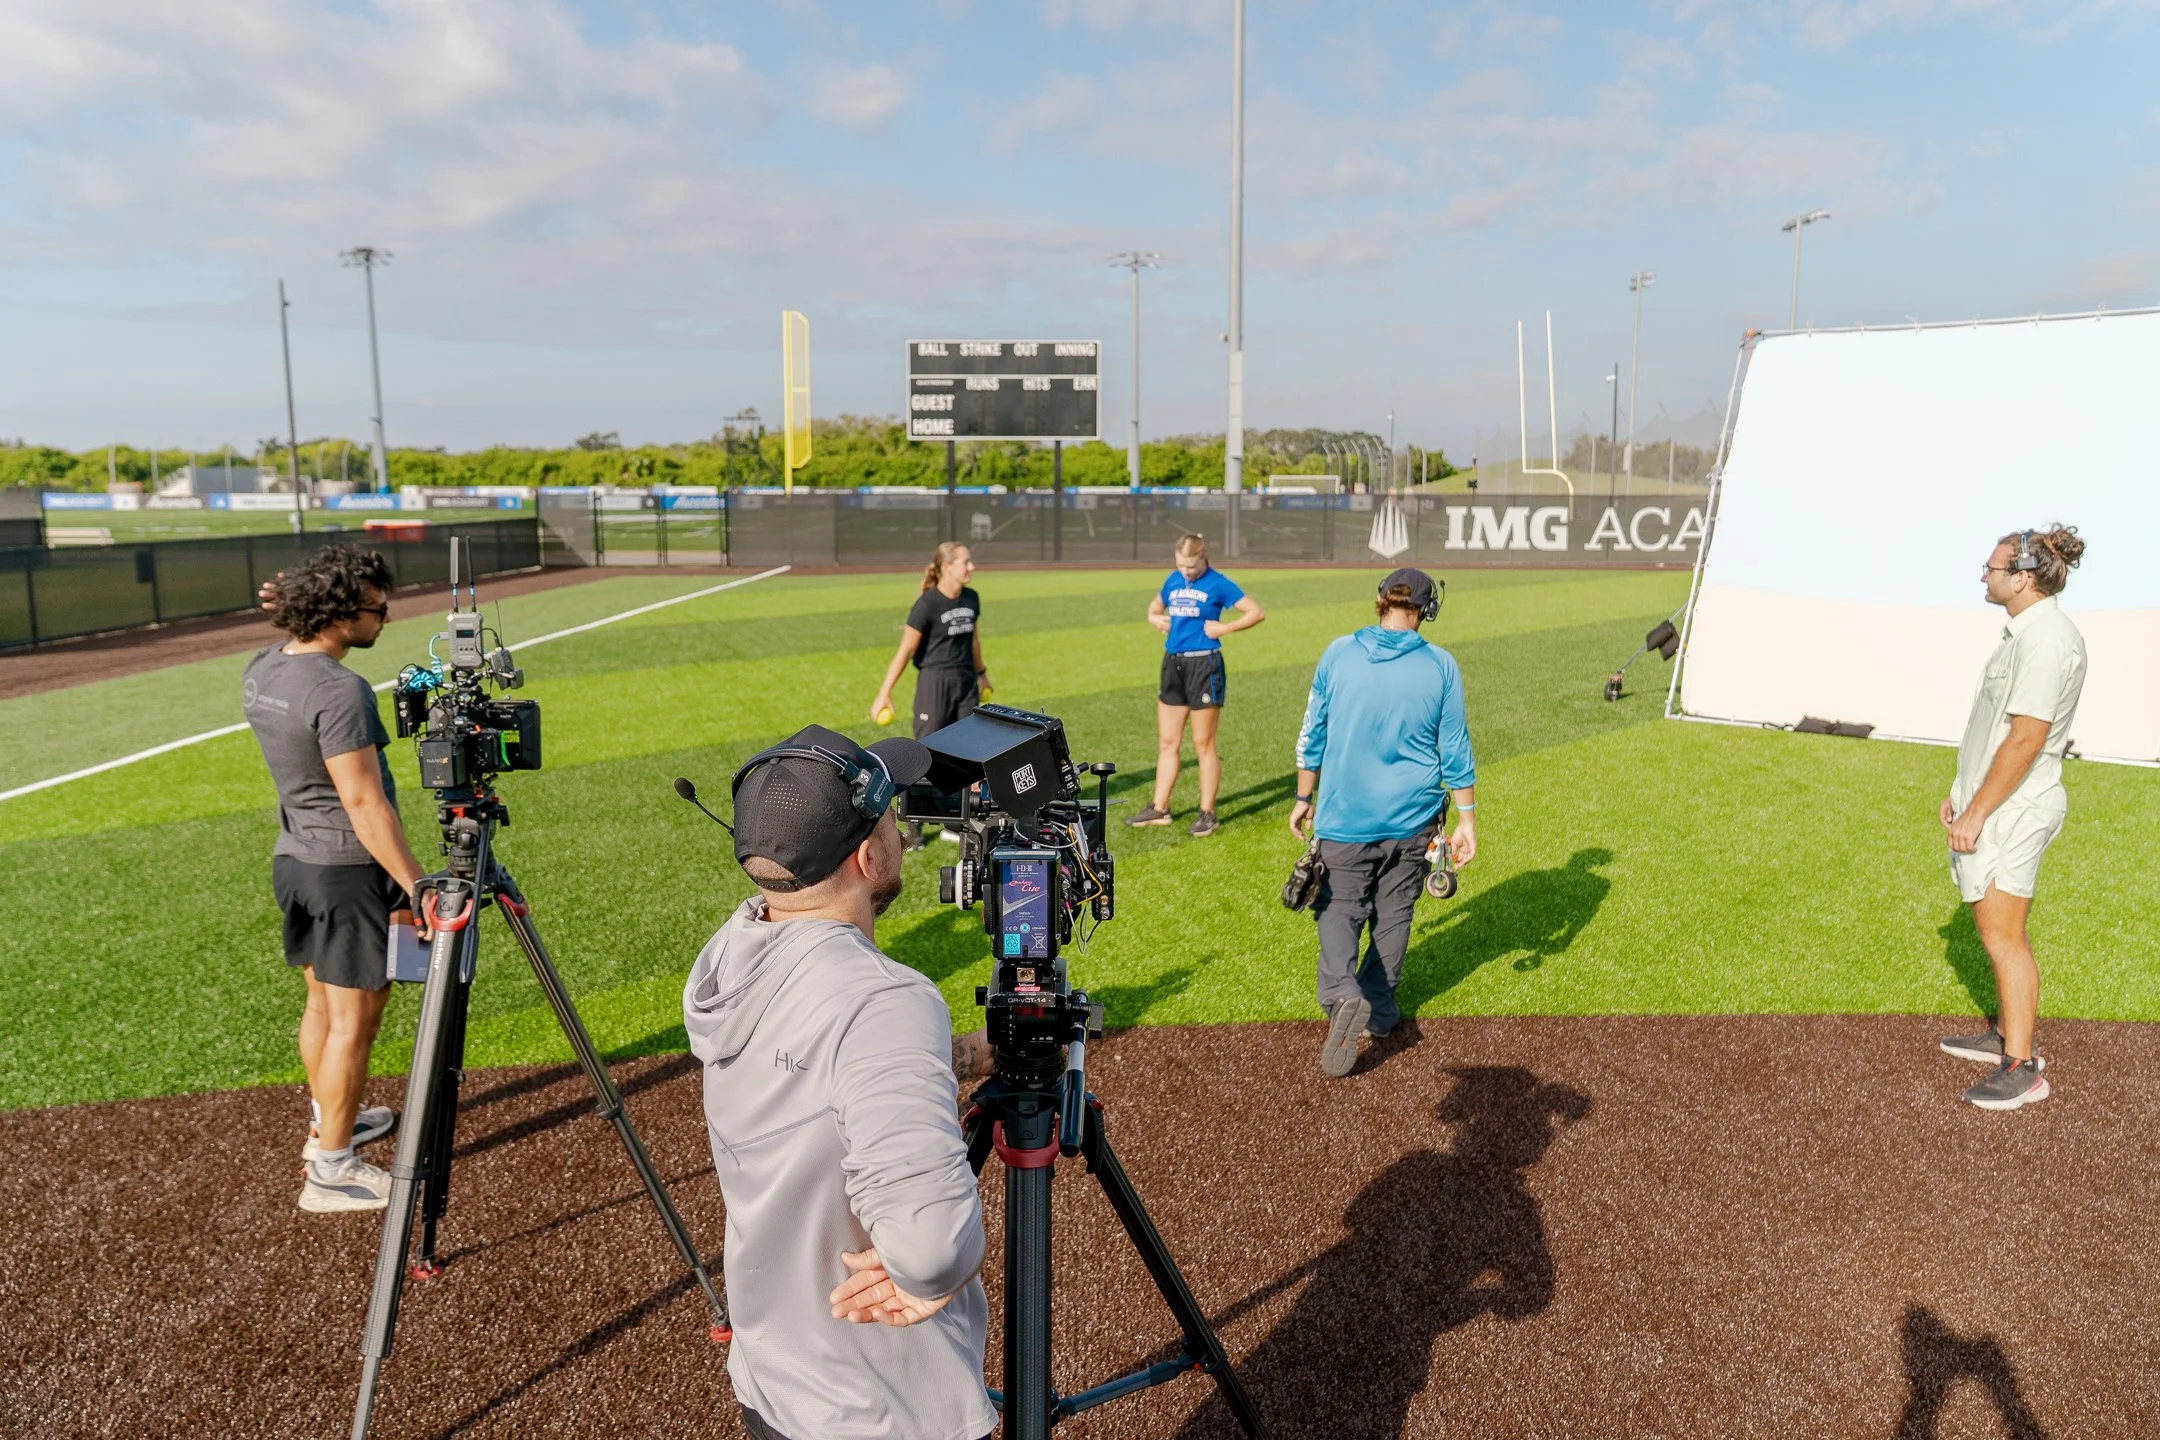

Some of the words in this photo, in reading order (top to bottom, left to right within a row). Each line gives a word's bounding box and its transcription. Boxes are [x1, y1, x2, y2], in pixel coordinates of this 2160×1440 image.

[918, 343, 949, 356] BALL
[960, 343, 1002, 356] STRIKE
[1014, 343, 1039, 356] OUT
[1055, 343, 1096, 356] INNING
[966, 377, 999, 391] RUNS
[1023, 377, 1051, 391] HITS
[911, 394, 955, 411] GUEST
[912, 418, 954, 434] HOME
[1445, 506, 1569, 551] IMG
[1014, 767, 1032, 781] PORT
[1016, 776, 1035, 791] KEYS
